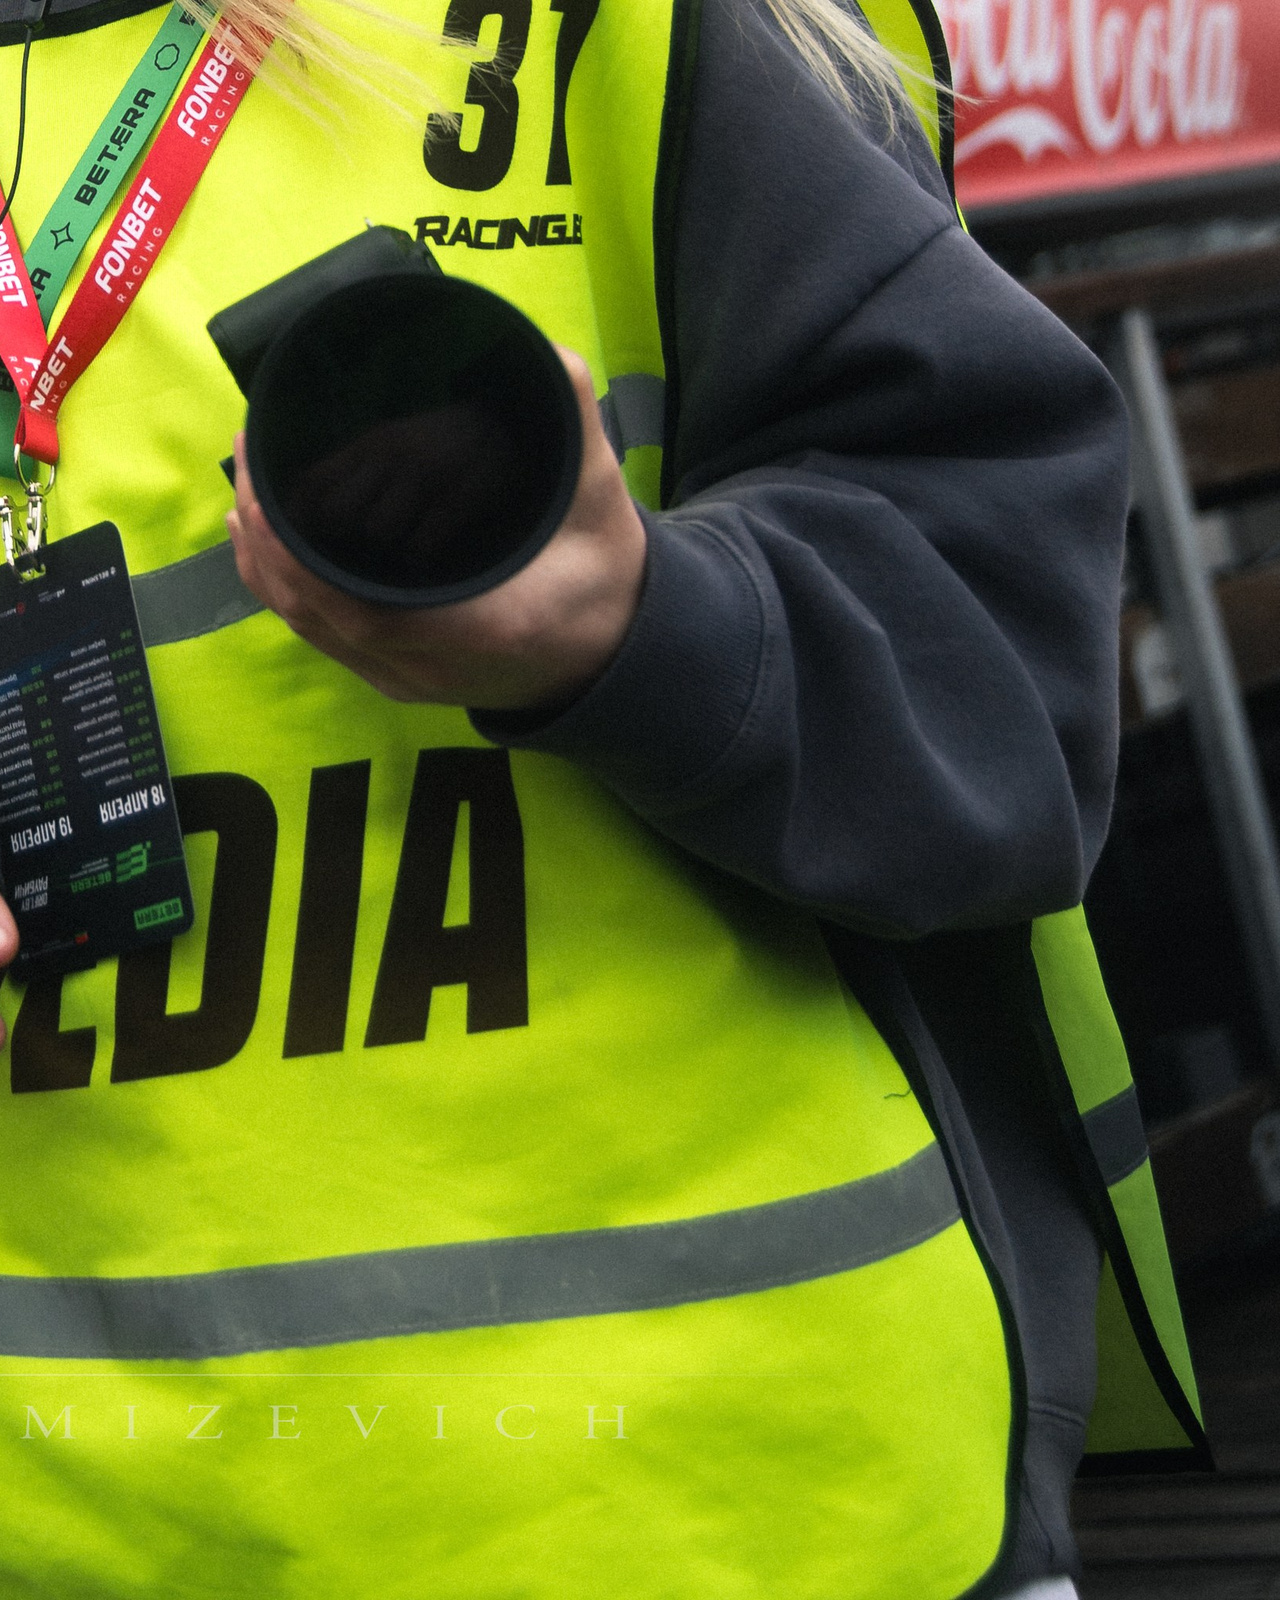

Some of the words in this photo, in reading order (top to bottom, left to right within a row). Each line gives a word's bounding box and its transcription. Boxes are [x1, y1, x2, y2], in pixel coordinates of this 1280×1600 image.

[177, 24, 244, 138] FONBET
[200, 70, 245, 146] RACING
[94, 177, 163, 295] FONBET
[116, 226, 163, 304] RACING
[29, 335, 75, 413] NBET
[58, 815, 72, 835] 19
[98, 789, 149, 823] АПРЕЛЯ
[150, 784, 165, 805] 18
[10, 820, 57, 852] АПРЕЛЯ
